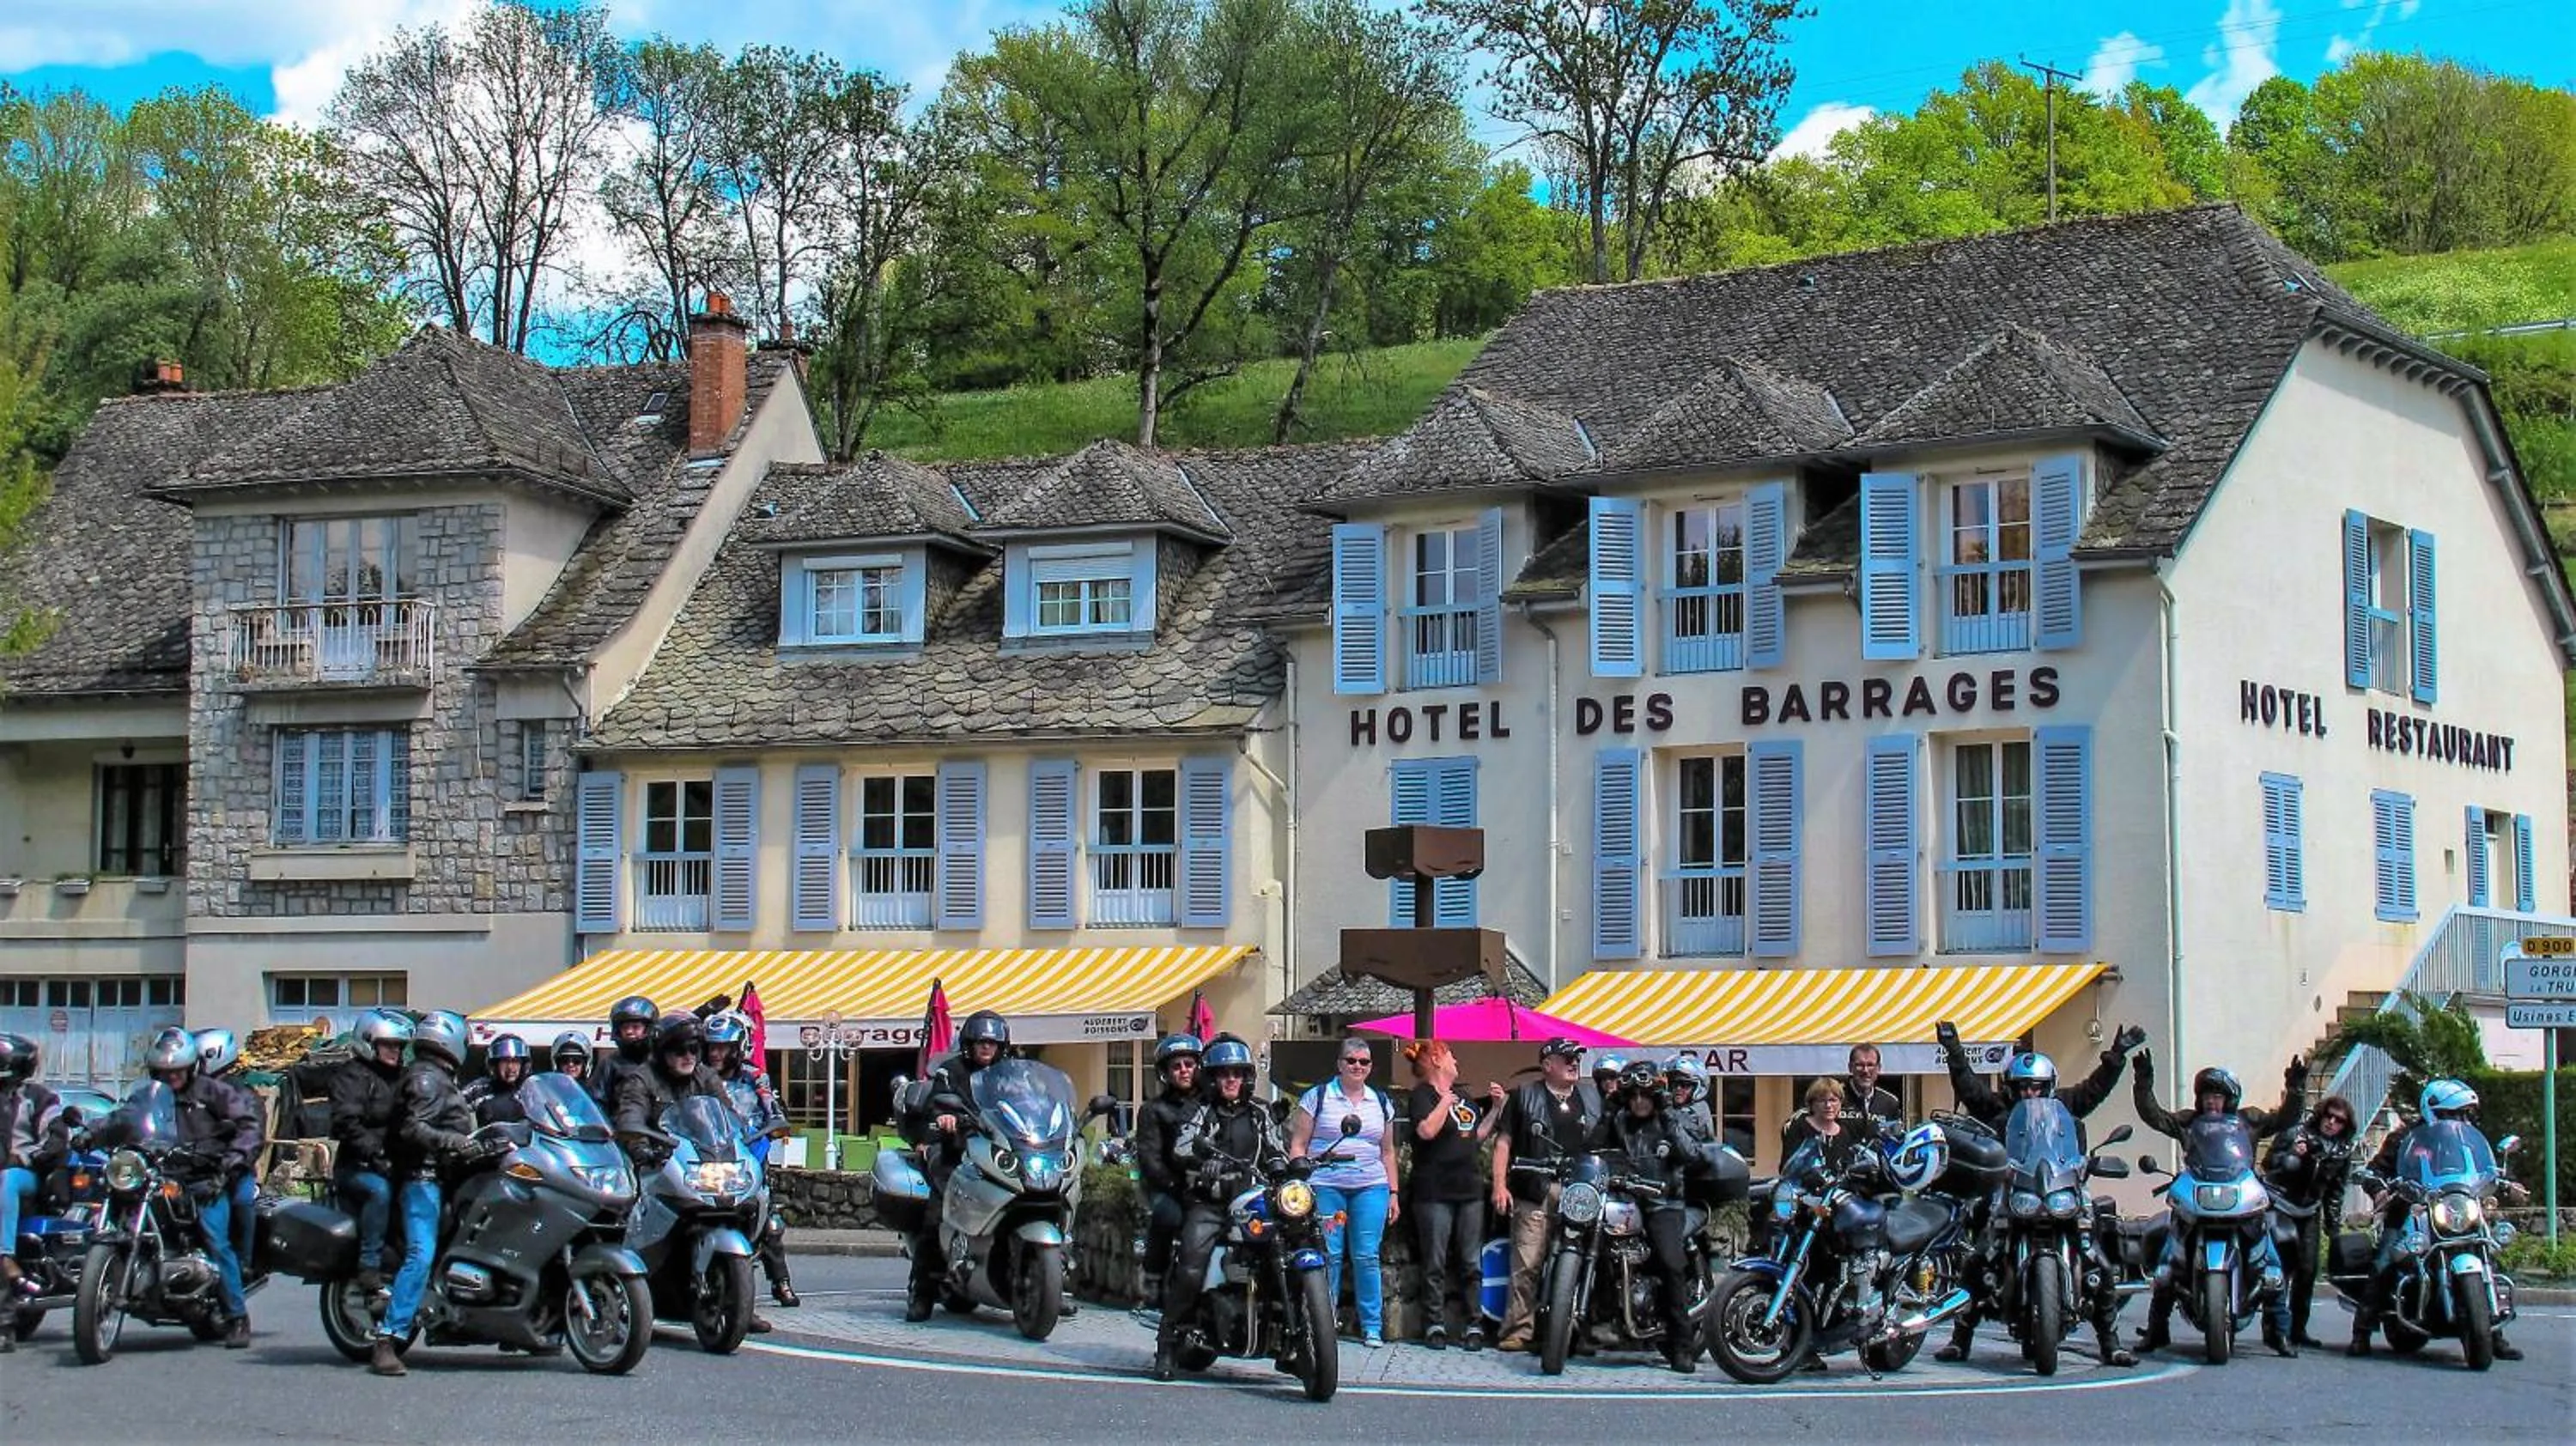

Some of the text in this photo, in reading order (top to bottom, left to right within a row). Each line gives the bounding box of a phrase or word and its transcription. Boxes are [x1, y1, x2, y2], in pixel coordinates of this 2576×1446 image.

[1351, 666, 2061, 746] HOTEL DES BARRAGES
[2239, 679, 2515, 773] HOTEL RESTAURANT
[2527, 940, 2572, 952] D 900
[2513, 1010, 2562, 1022] Usines
[1084, 1025, 1129, 1035] BOISSONS
[1680, 1049, 1750, 1072] AR
